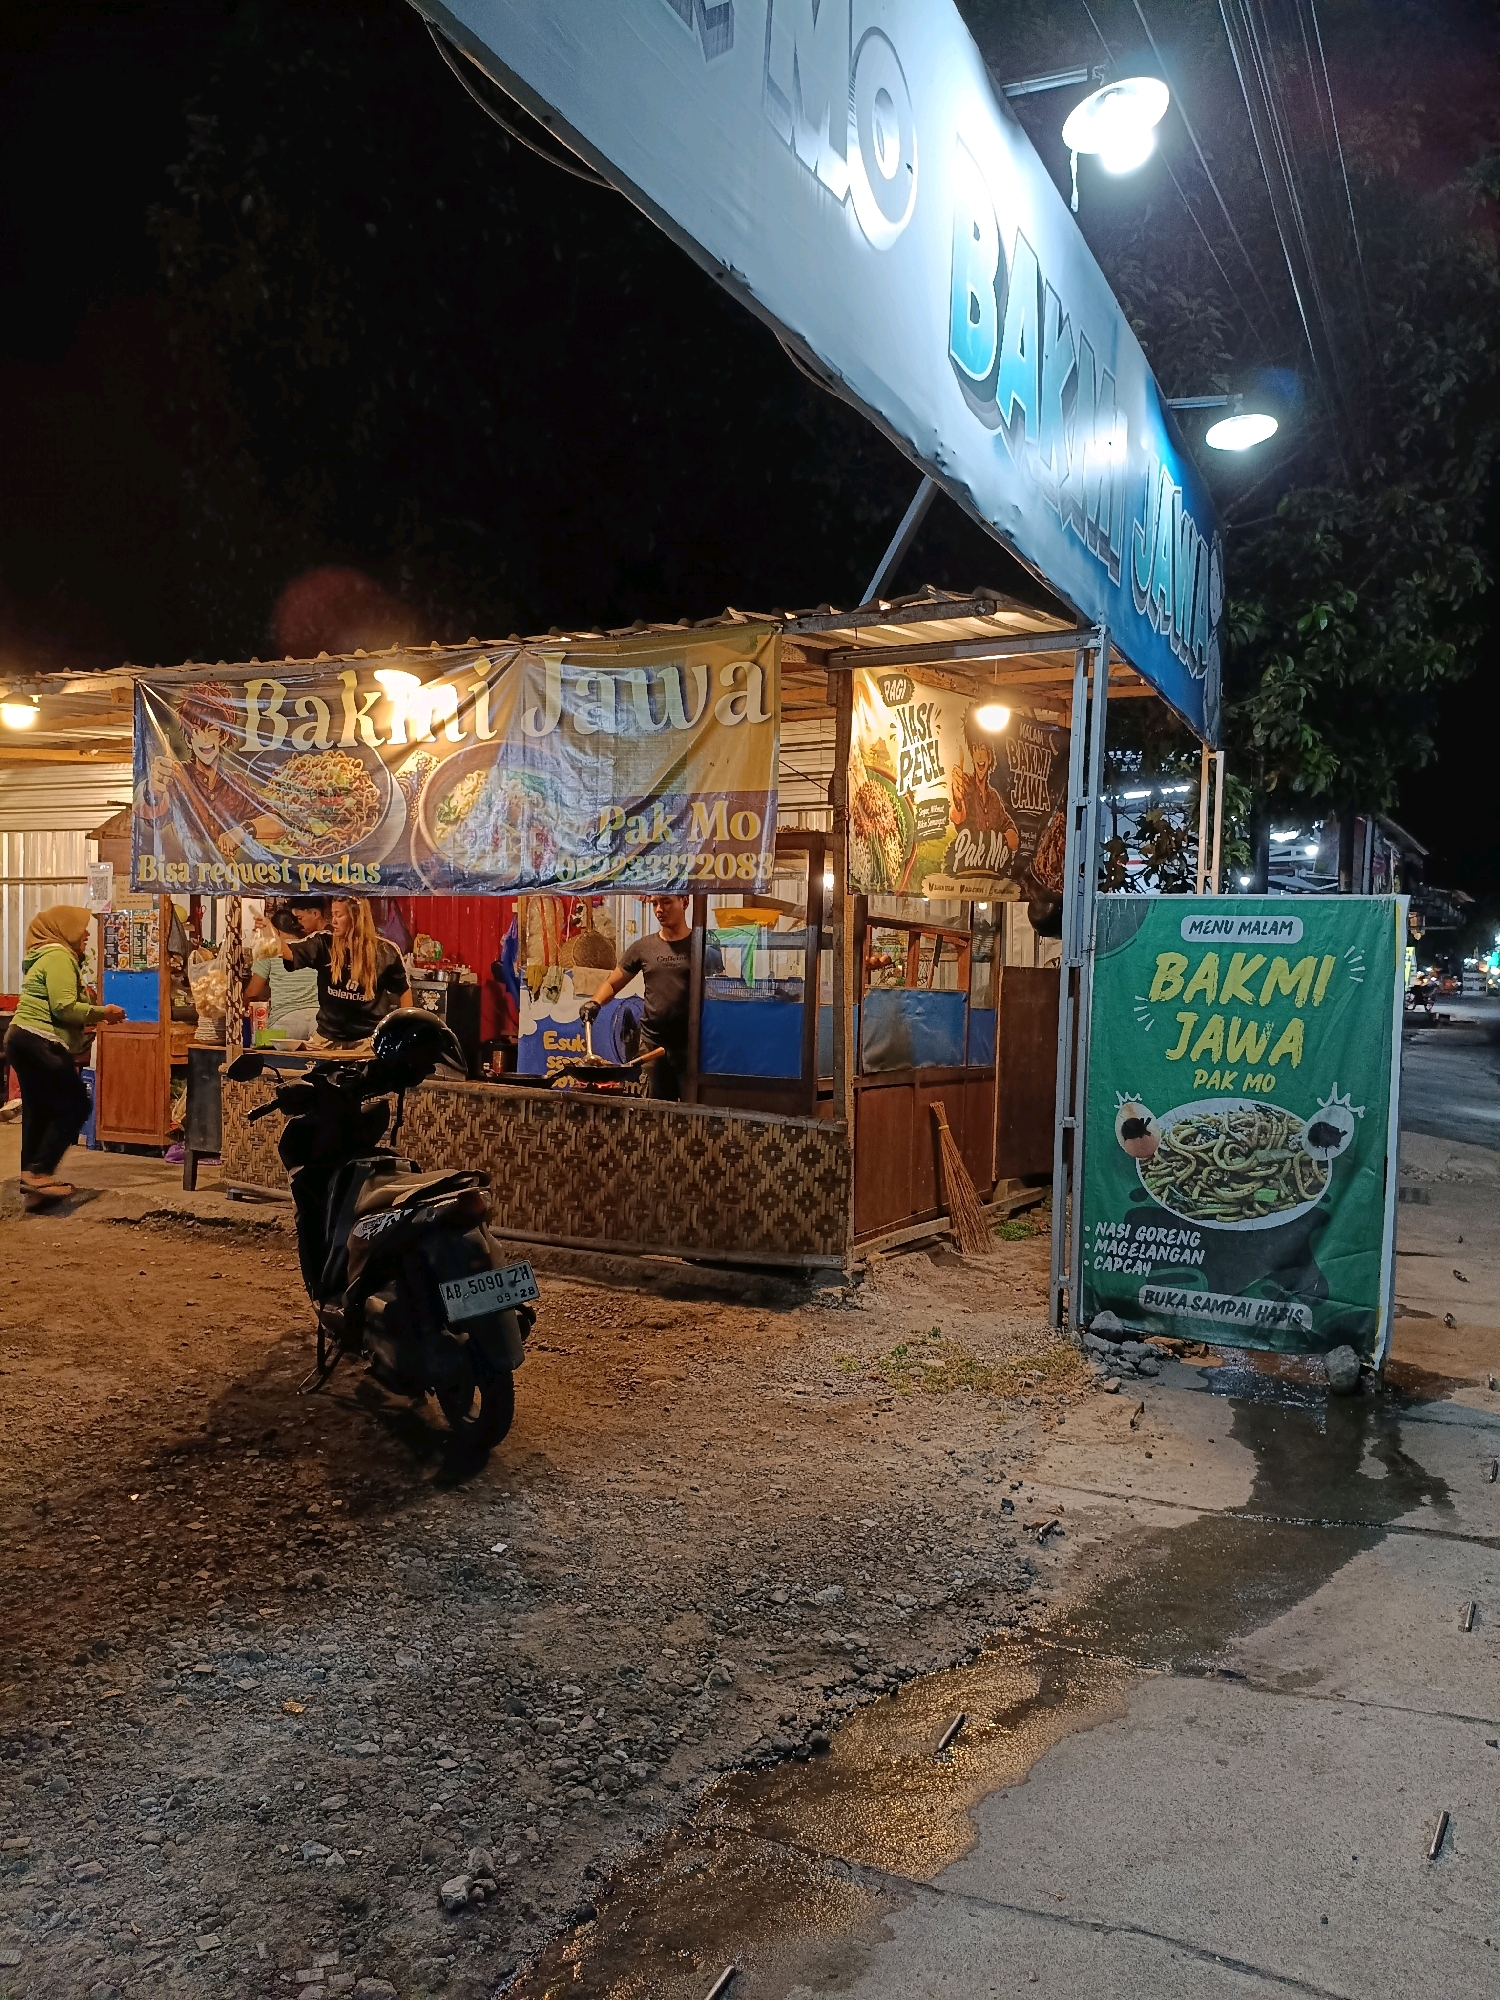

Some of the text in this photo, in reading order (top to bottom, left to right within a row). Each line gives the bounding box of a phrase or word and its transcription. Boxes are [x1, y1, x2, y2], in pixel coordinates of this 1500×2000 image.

[948, 130, 1127, 588] BAKMI
[1131, 450, 1212, 680] JAWA
[239, 652, 772, 752] Bakmi Jawa
[883, 679, 907, 702] PAGI
[896, 702, 935, 749] NASI
[1019, 722, 1045, 746] MALAM
[899, 739, 946, 794] PECEL
[1005, 737, 1052, 782] BAKMI
[1010, 765, 1051, 812] JAWA
[598, 799, 762, 846] Pak Mo
[952, 828, 986, 873] Pak
[985, 829, 1010, 872] Mo
[137, 853, 382, 892] Bisa request pedas
[1188, 919, 1294, 937] MENU MALAM
[1148, 951, 1337, 1009] BAKMI
[543, 1030, 587, 1053] Esuk
[1165, 1011, 1305, 1069] JAWA
[1193, 1068, 1277, 1093] PAK MO
[1093, 1239, 1206, 1265] MAGELANGAN
[1095, 1221, 1201, 1247] NASI GORENG
[1093, 1255, 1152, 1278] CAPCAY
[445, 1284, 463, 1301] AB
[467, 1272, 504, 1295] 5090
[1143, 1289, 1305, 1326] BUKA SAMPAI HABIS
